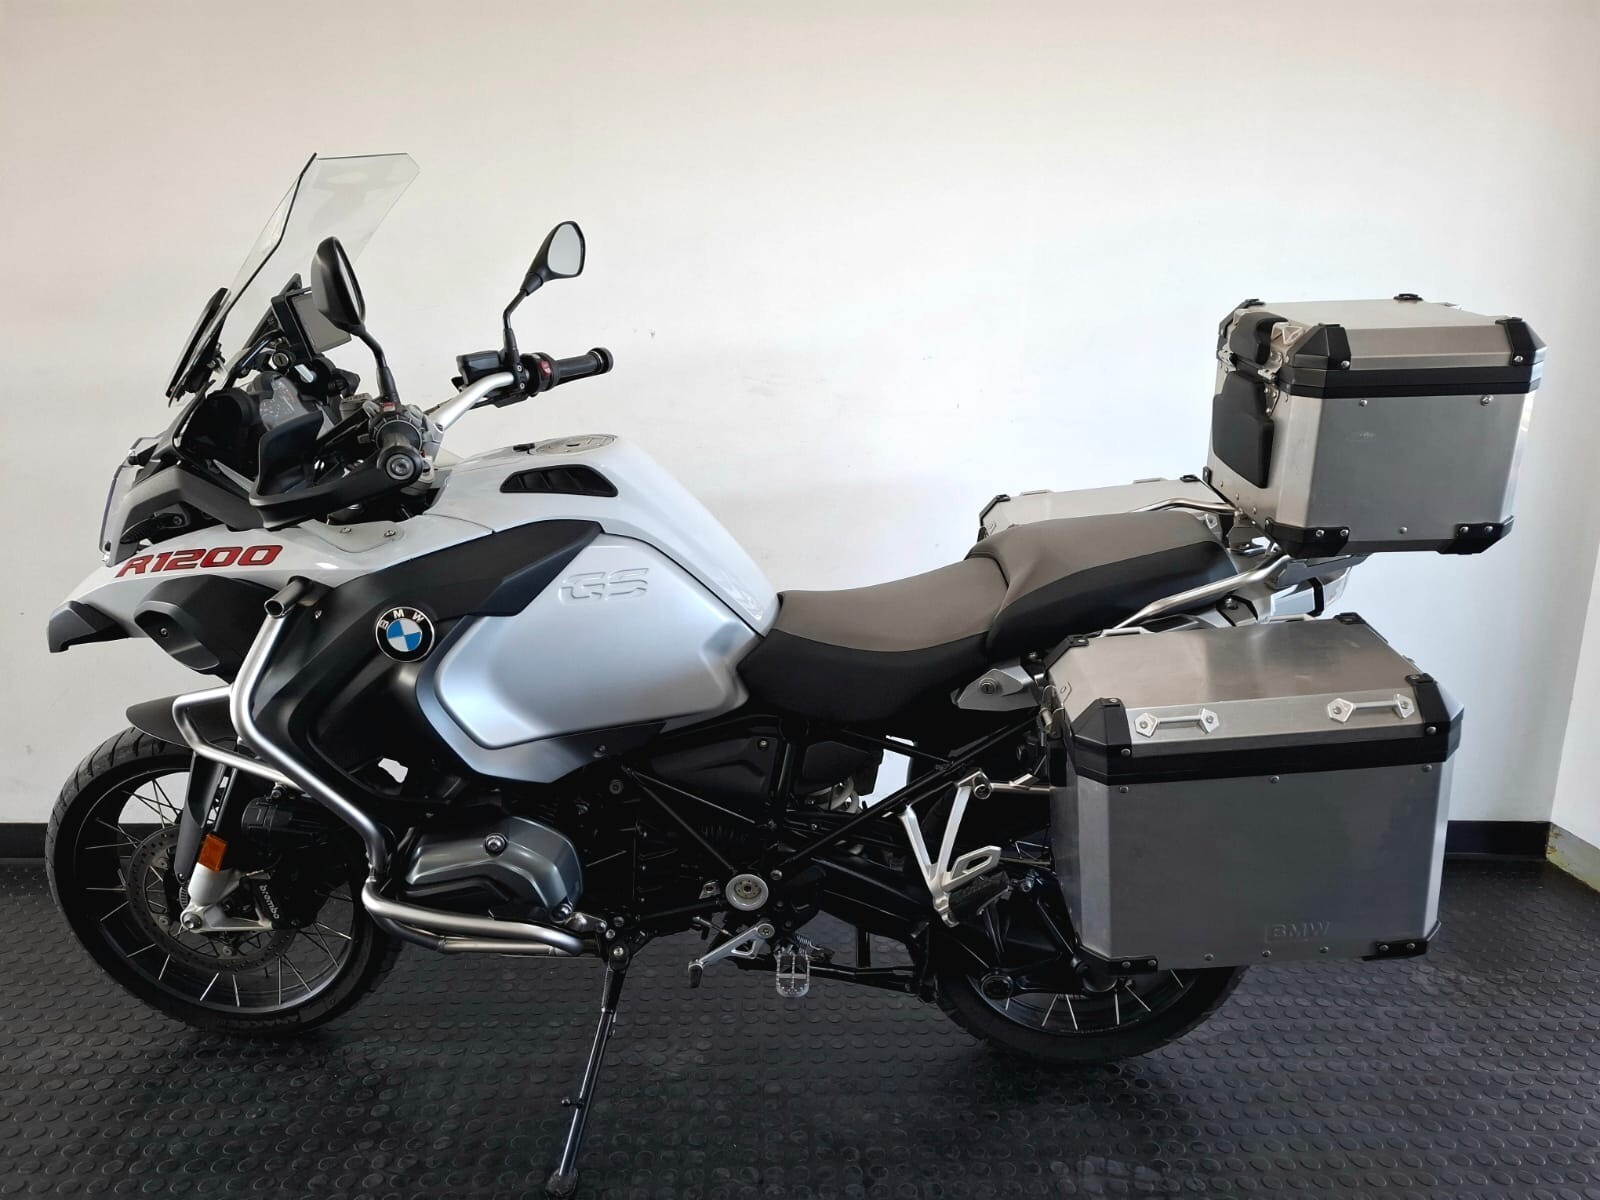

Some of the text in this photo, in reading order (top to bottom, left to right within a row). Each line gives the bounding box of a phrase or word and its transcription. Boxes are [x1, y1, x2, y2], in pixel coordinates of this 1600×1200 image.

[114, 544, 284, 579] R1200
[559, 567, 649, 605] GS
[378, 608, 425, 630] BMW
[259, 884, 280, 919] brembo
[1271, 920, 1331, 938] BMW
